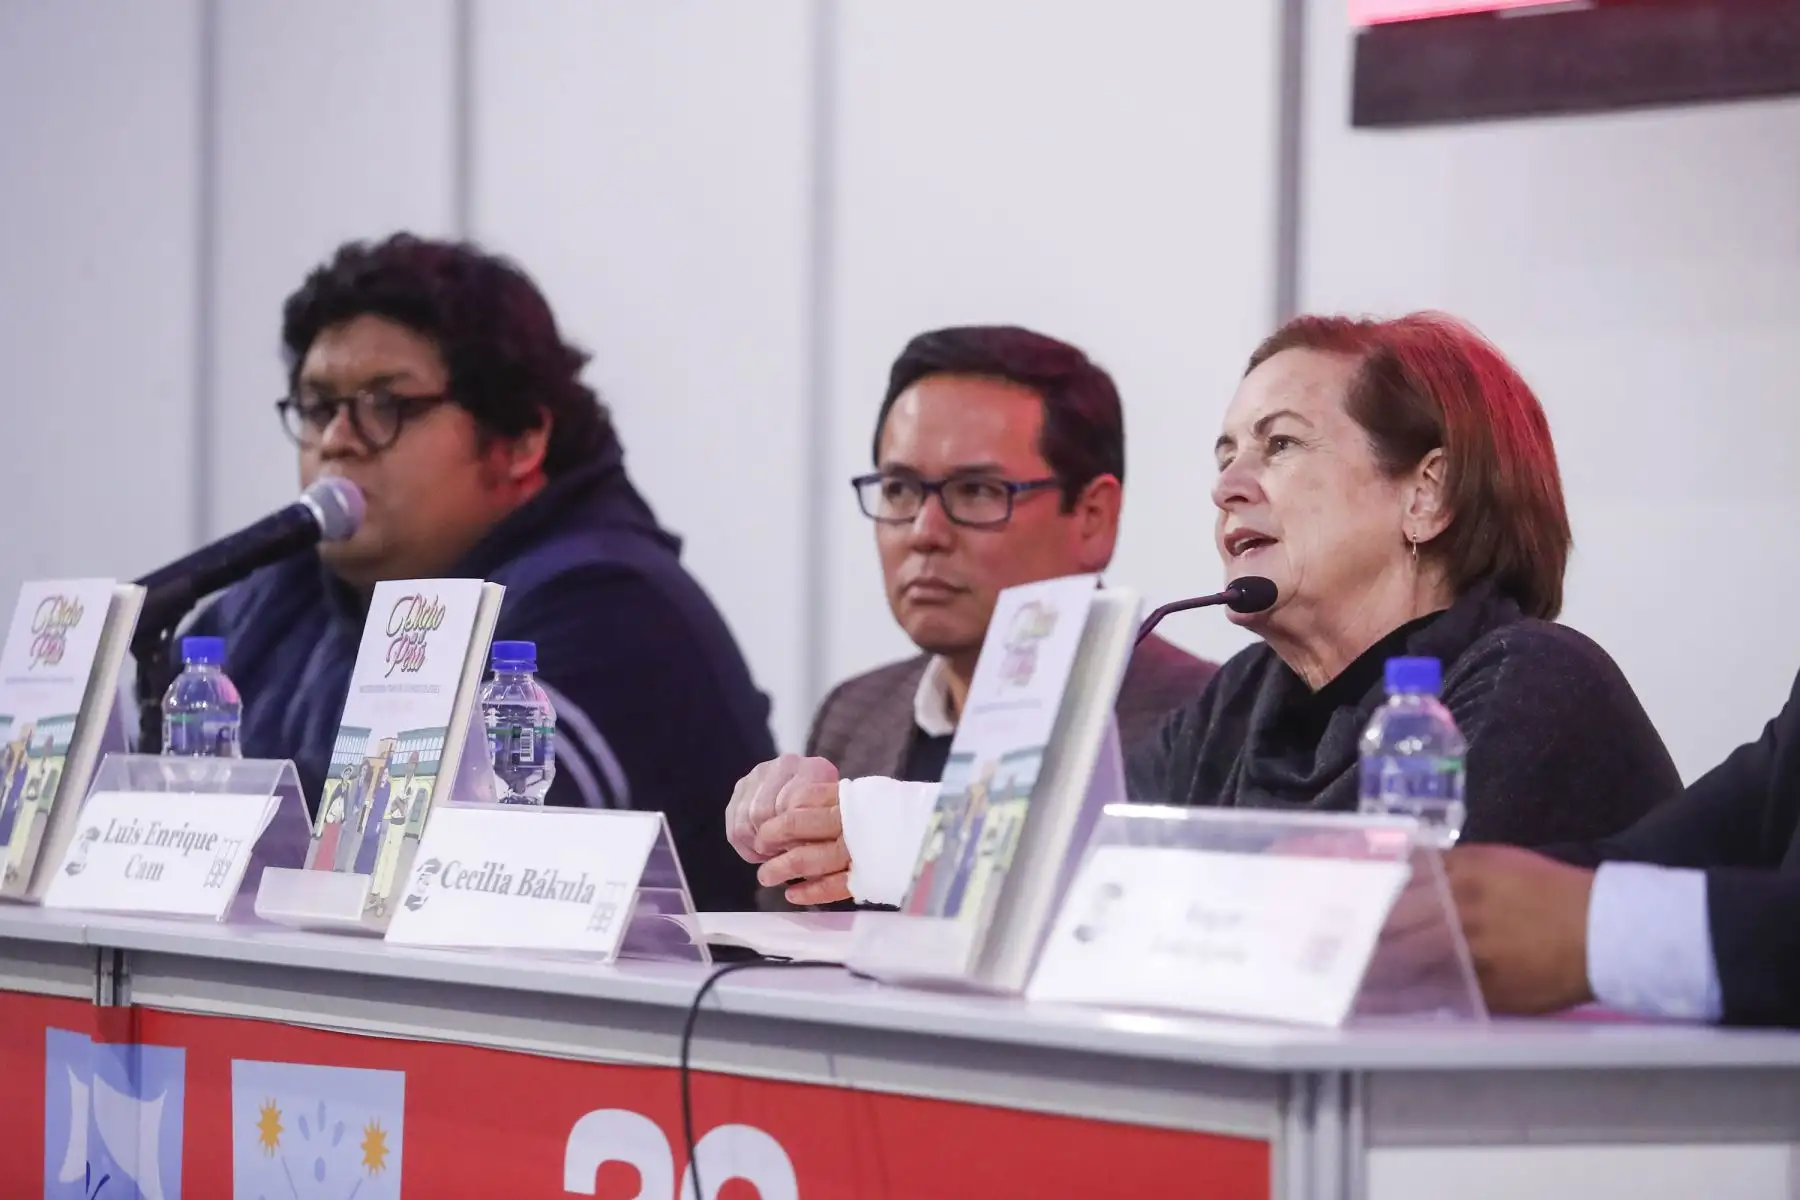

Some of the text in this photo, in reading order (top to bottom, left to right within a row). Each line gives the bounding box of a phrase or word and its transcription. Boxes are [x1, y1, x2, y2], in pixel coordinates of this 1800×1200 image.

[103, 817, 219, 857] Luis Enrique
[440, 859, 597, 905] Cecilia Bákula
